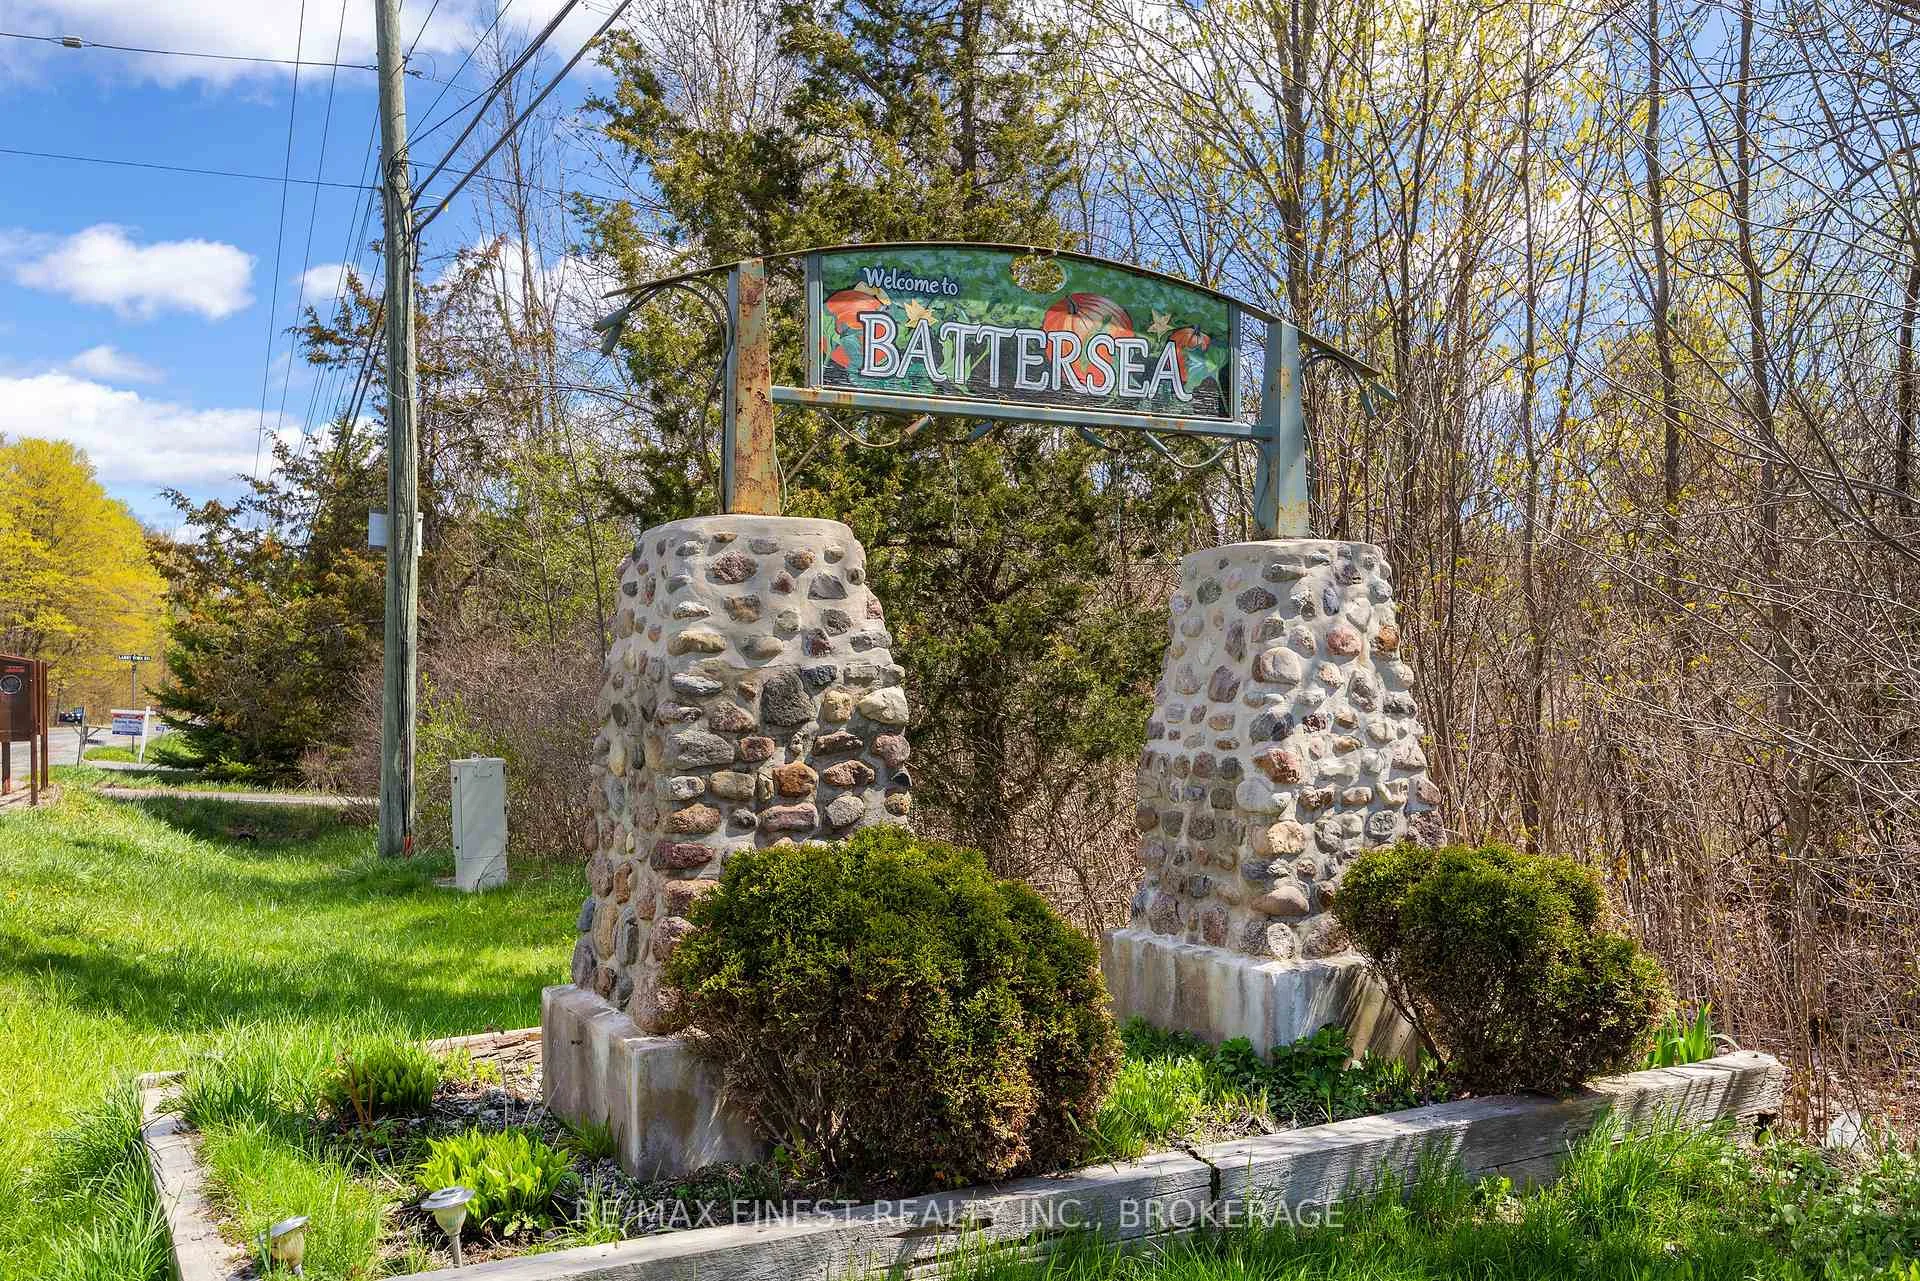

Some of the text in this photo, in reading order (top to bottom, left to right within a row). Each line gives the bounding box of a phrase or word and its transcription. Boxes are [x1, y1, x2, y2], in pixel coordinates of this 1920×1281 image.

[863, 266, 959, 296] Welcome to
[858, 312, 1193, 402] BATTERSEA
